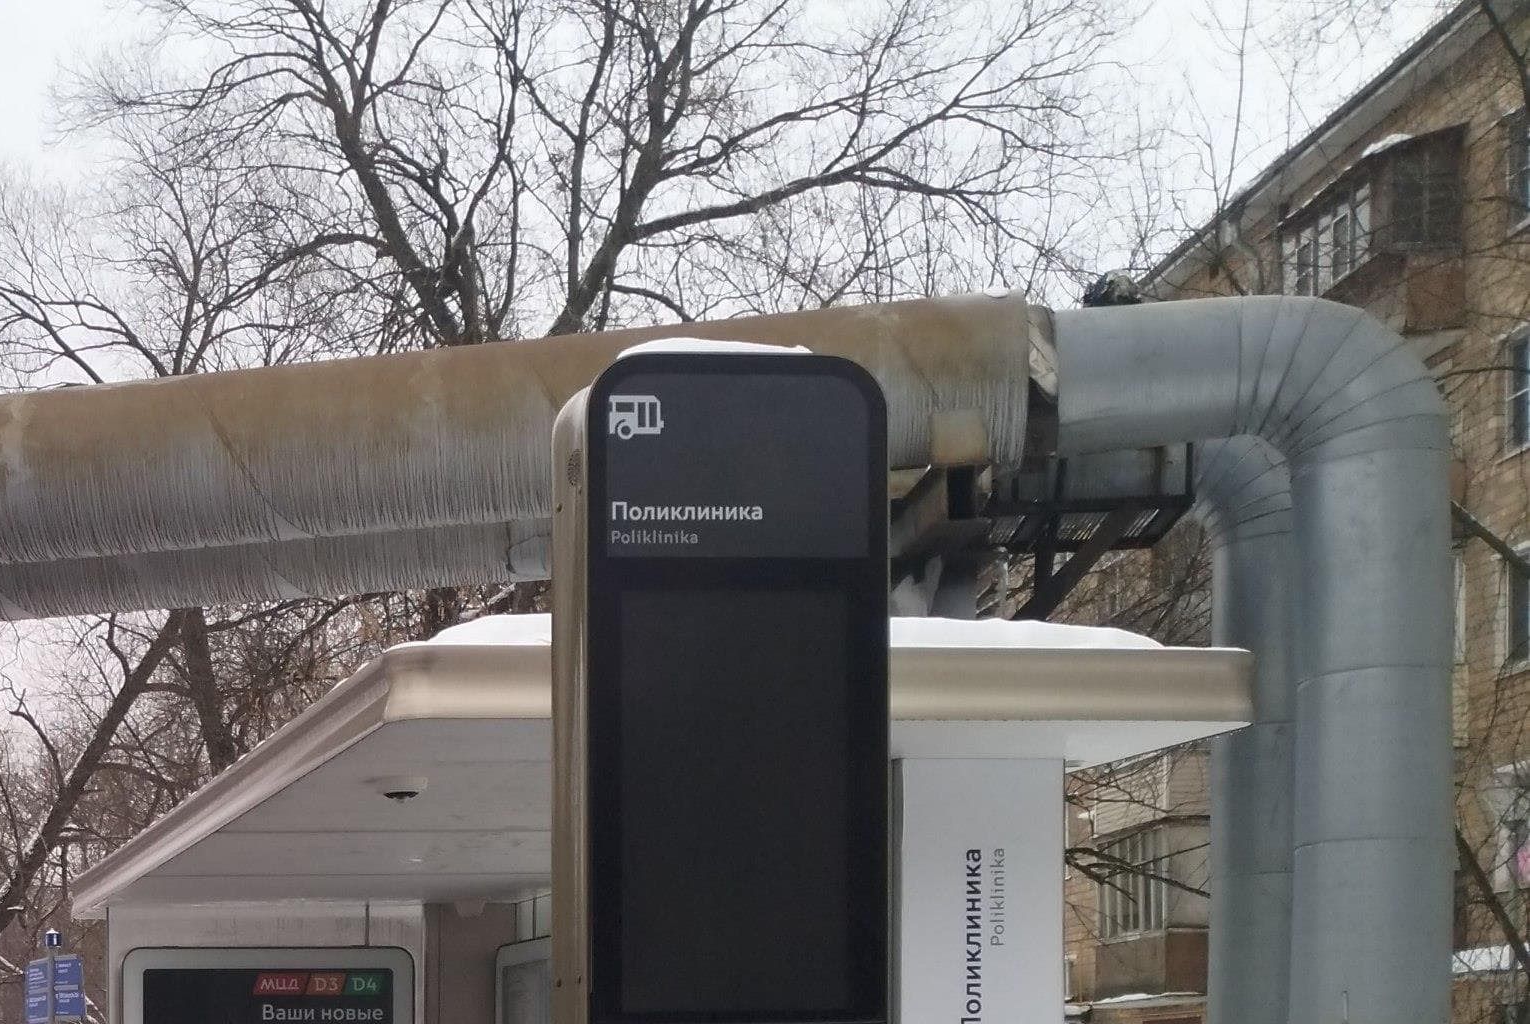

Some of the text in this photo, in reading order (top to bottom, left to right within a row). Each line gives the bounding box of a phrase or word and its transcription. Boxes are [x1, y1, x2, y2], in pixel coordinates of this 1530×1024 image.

[611, 501, 764, 521] Поликлиника
[611, 530, 699, 544] Poliklinika
[989, 847, 1005, 946] Poliklinika
[260, 978, 377, 991] МЦД D3 D4
[262, 1004, 384, 1021] Ваши новые
